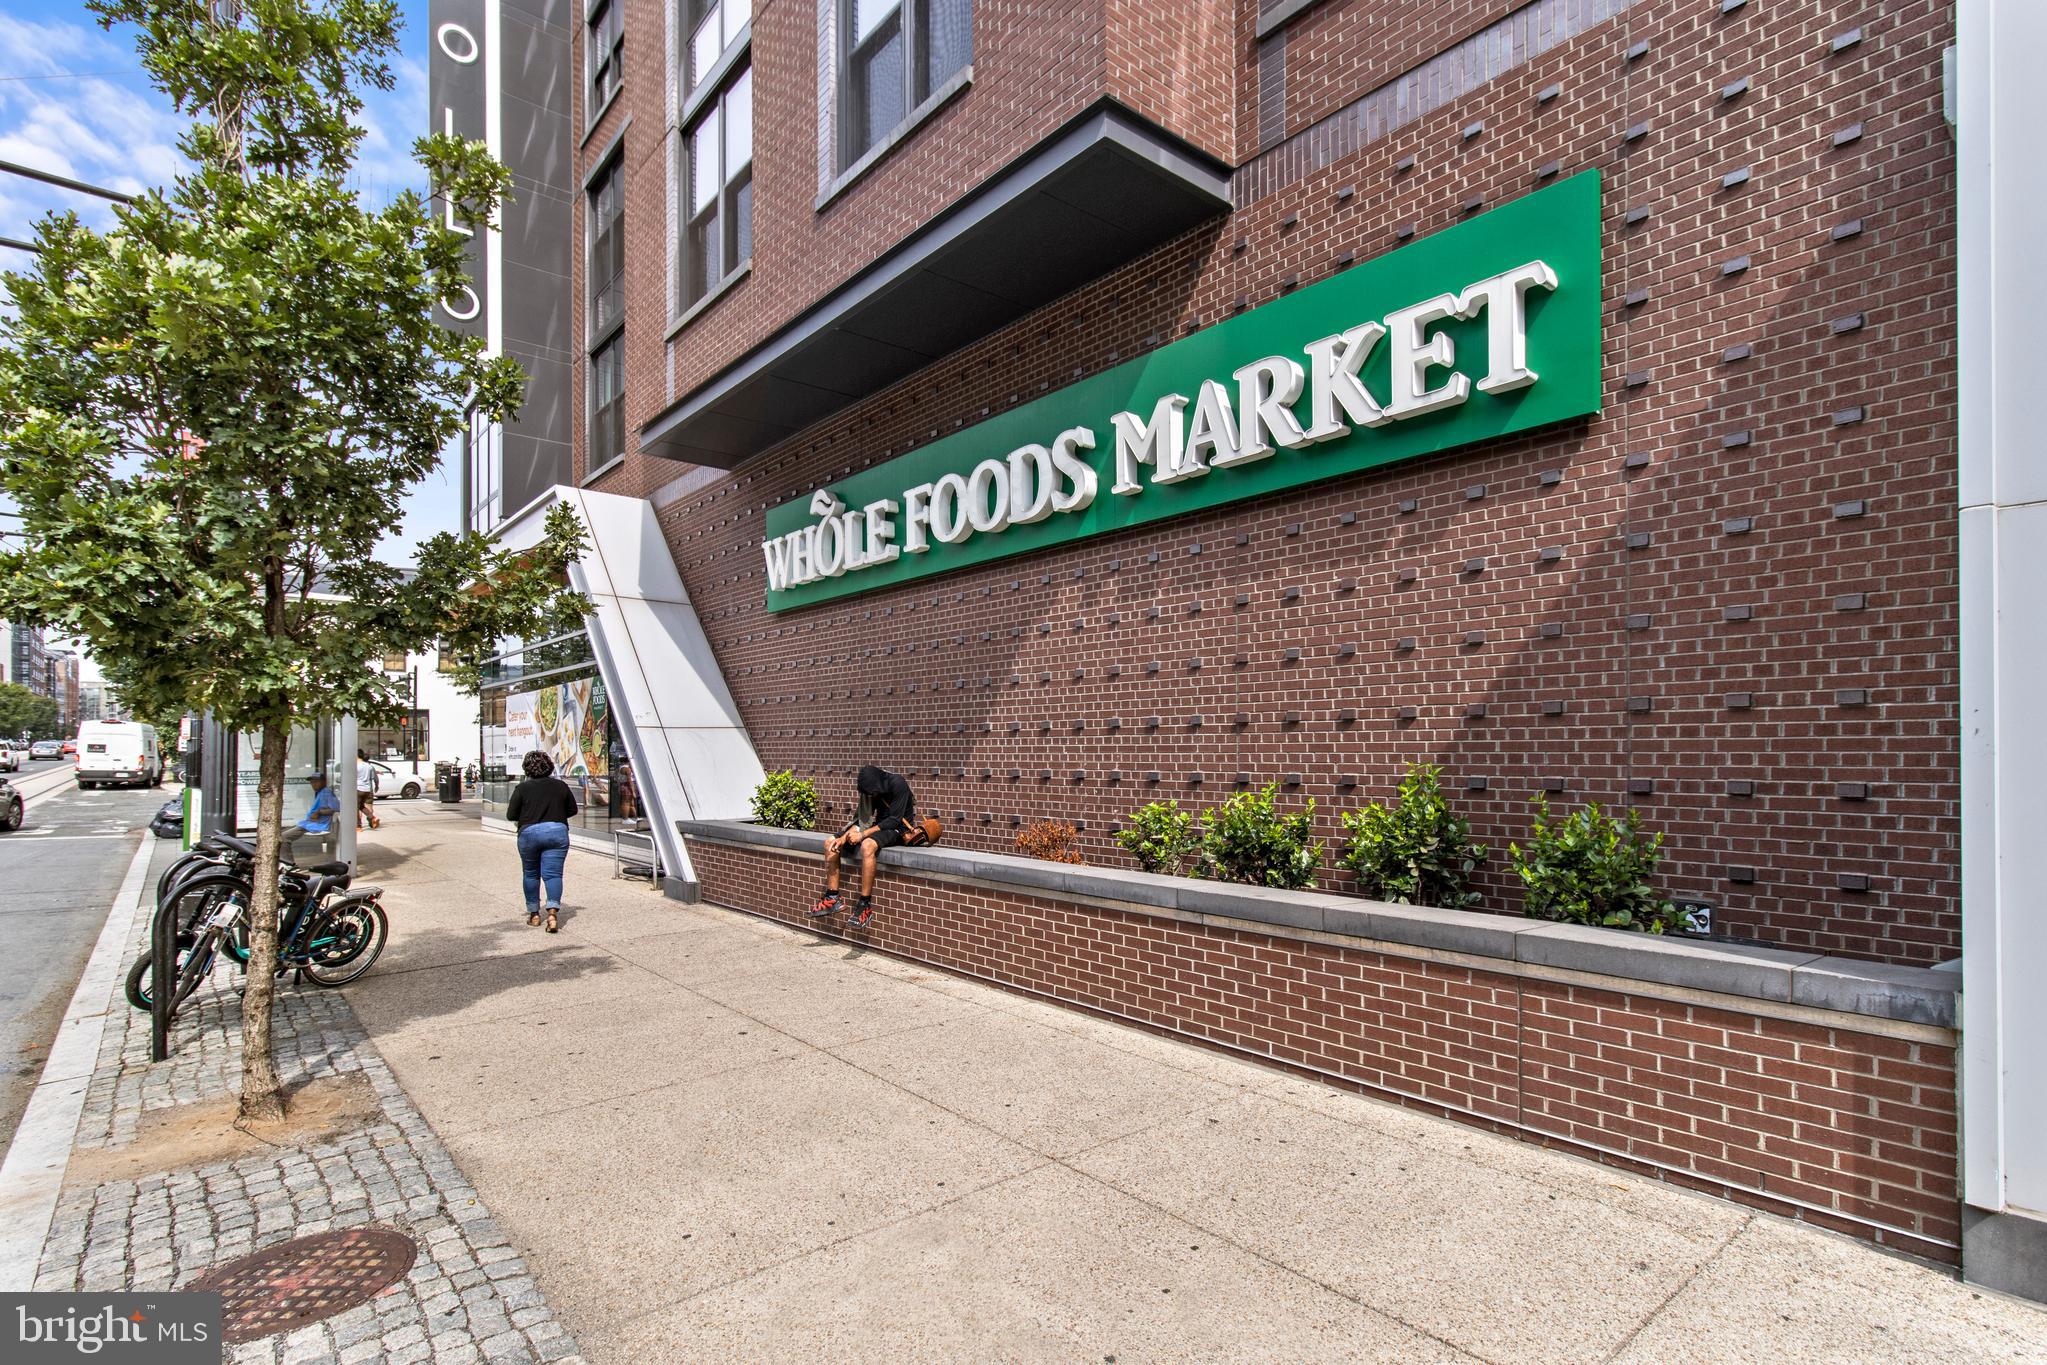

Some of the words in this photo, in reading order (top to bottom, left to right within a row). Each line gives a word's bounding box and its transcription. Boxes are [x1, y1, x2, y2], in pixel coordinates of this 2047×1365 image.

[762, 489, 899, 592] WHOLE
[903, 426, 1097, 553] FOODS
[1110, 260, 1558, 496] MARKET
